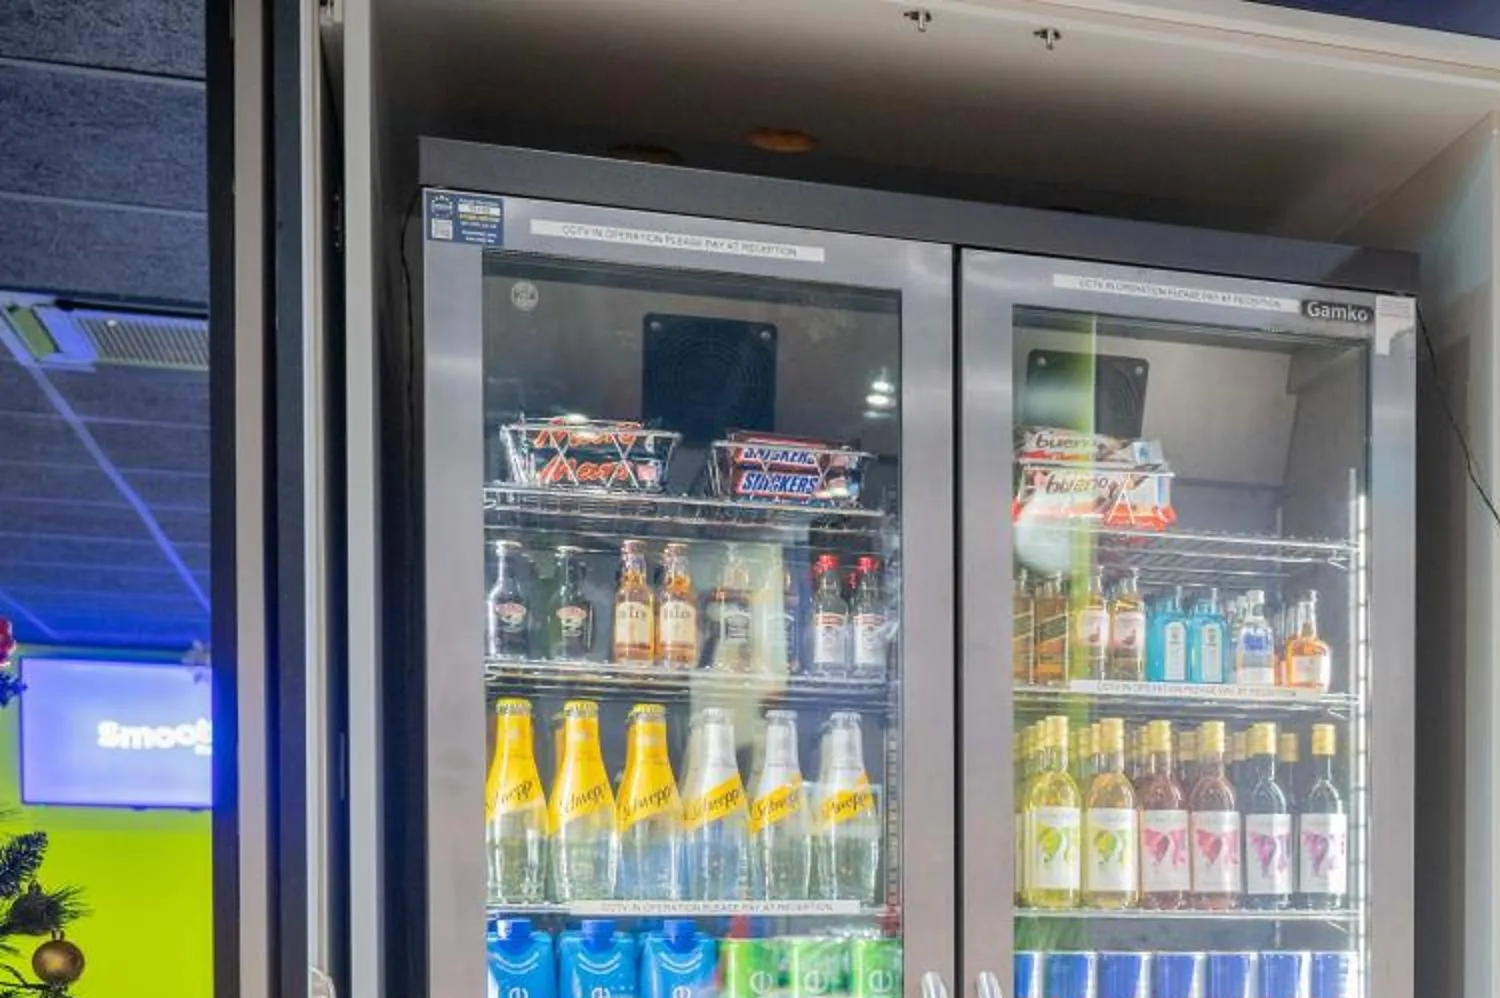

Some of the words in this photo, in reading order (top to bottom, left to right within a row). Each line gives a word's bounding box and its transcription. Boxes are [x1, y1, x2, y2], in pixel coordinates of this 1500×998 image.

[562, 224, 588, 237] CCTV
[604, 228, 663, 243] OPERATION
[664, 233, 702, 248] PLEASE
[705, 238, 725, 250] PAY
[741, 242, 798, 257] RECEPTION
[1307, 300, 1369, 323] Gamko
[742, 473, 819, 495] SNICKERS
